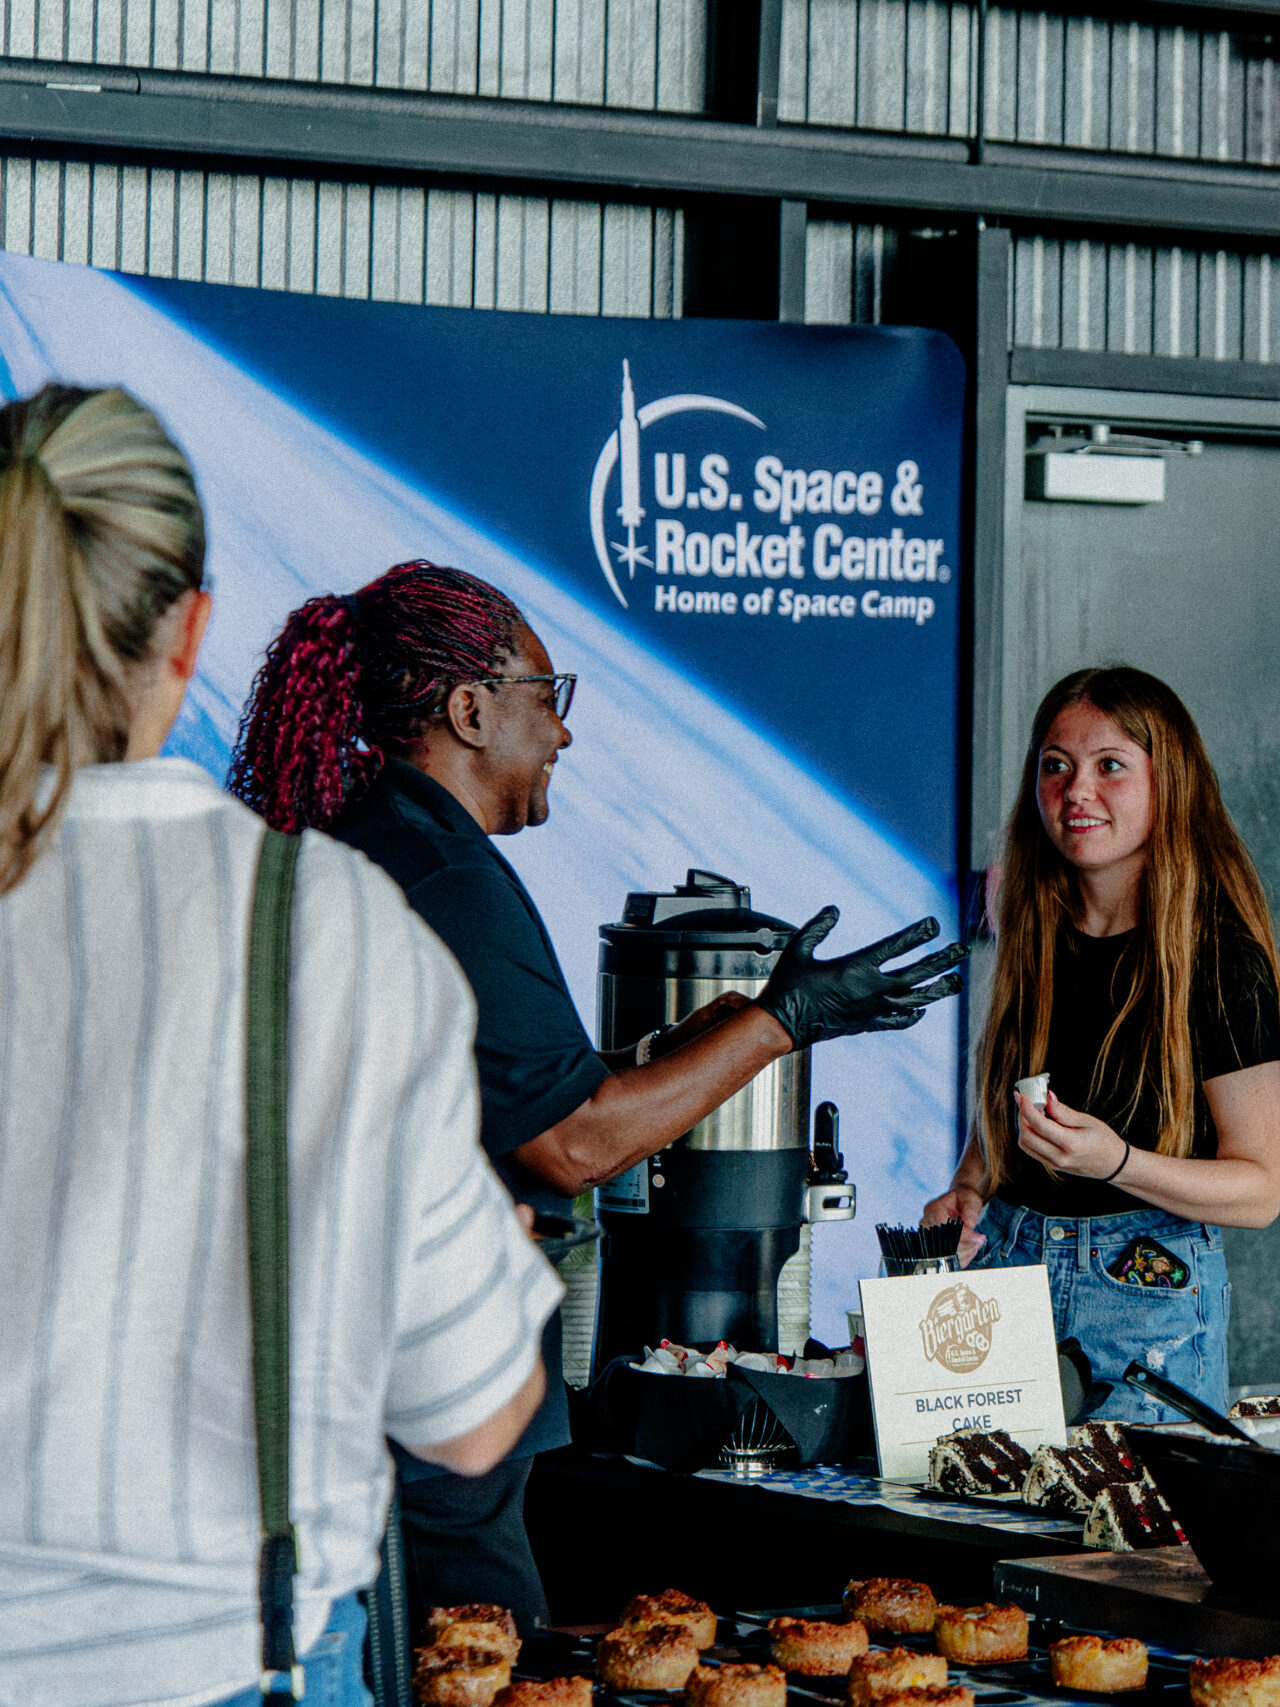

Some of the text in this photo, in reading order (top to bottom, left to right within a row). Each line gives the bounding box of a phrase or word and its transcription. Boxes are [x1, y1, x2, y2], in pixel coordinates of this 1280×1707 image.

[654, 452, 924, 525] U.S. Space &
[655, 519, 806, 579] Rocket
[654, 585, 935, 626] Home of Space Camp
[920, 1299, 999, 1360] Biergarten
[916, 1389, 1022, 1412] BLACK FOREST
[952, 1414, 992, 1430] CAKE
